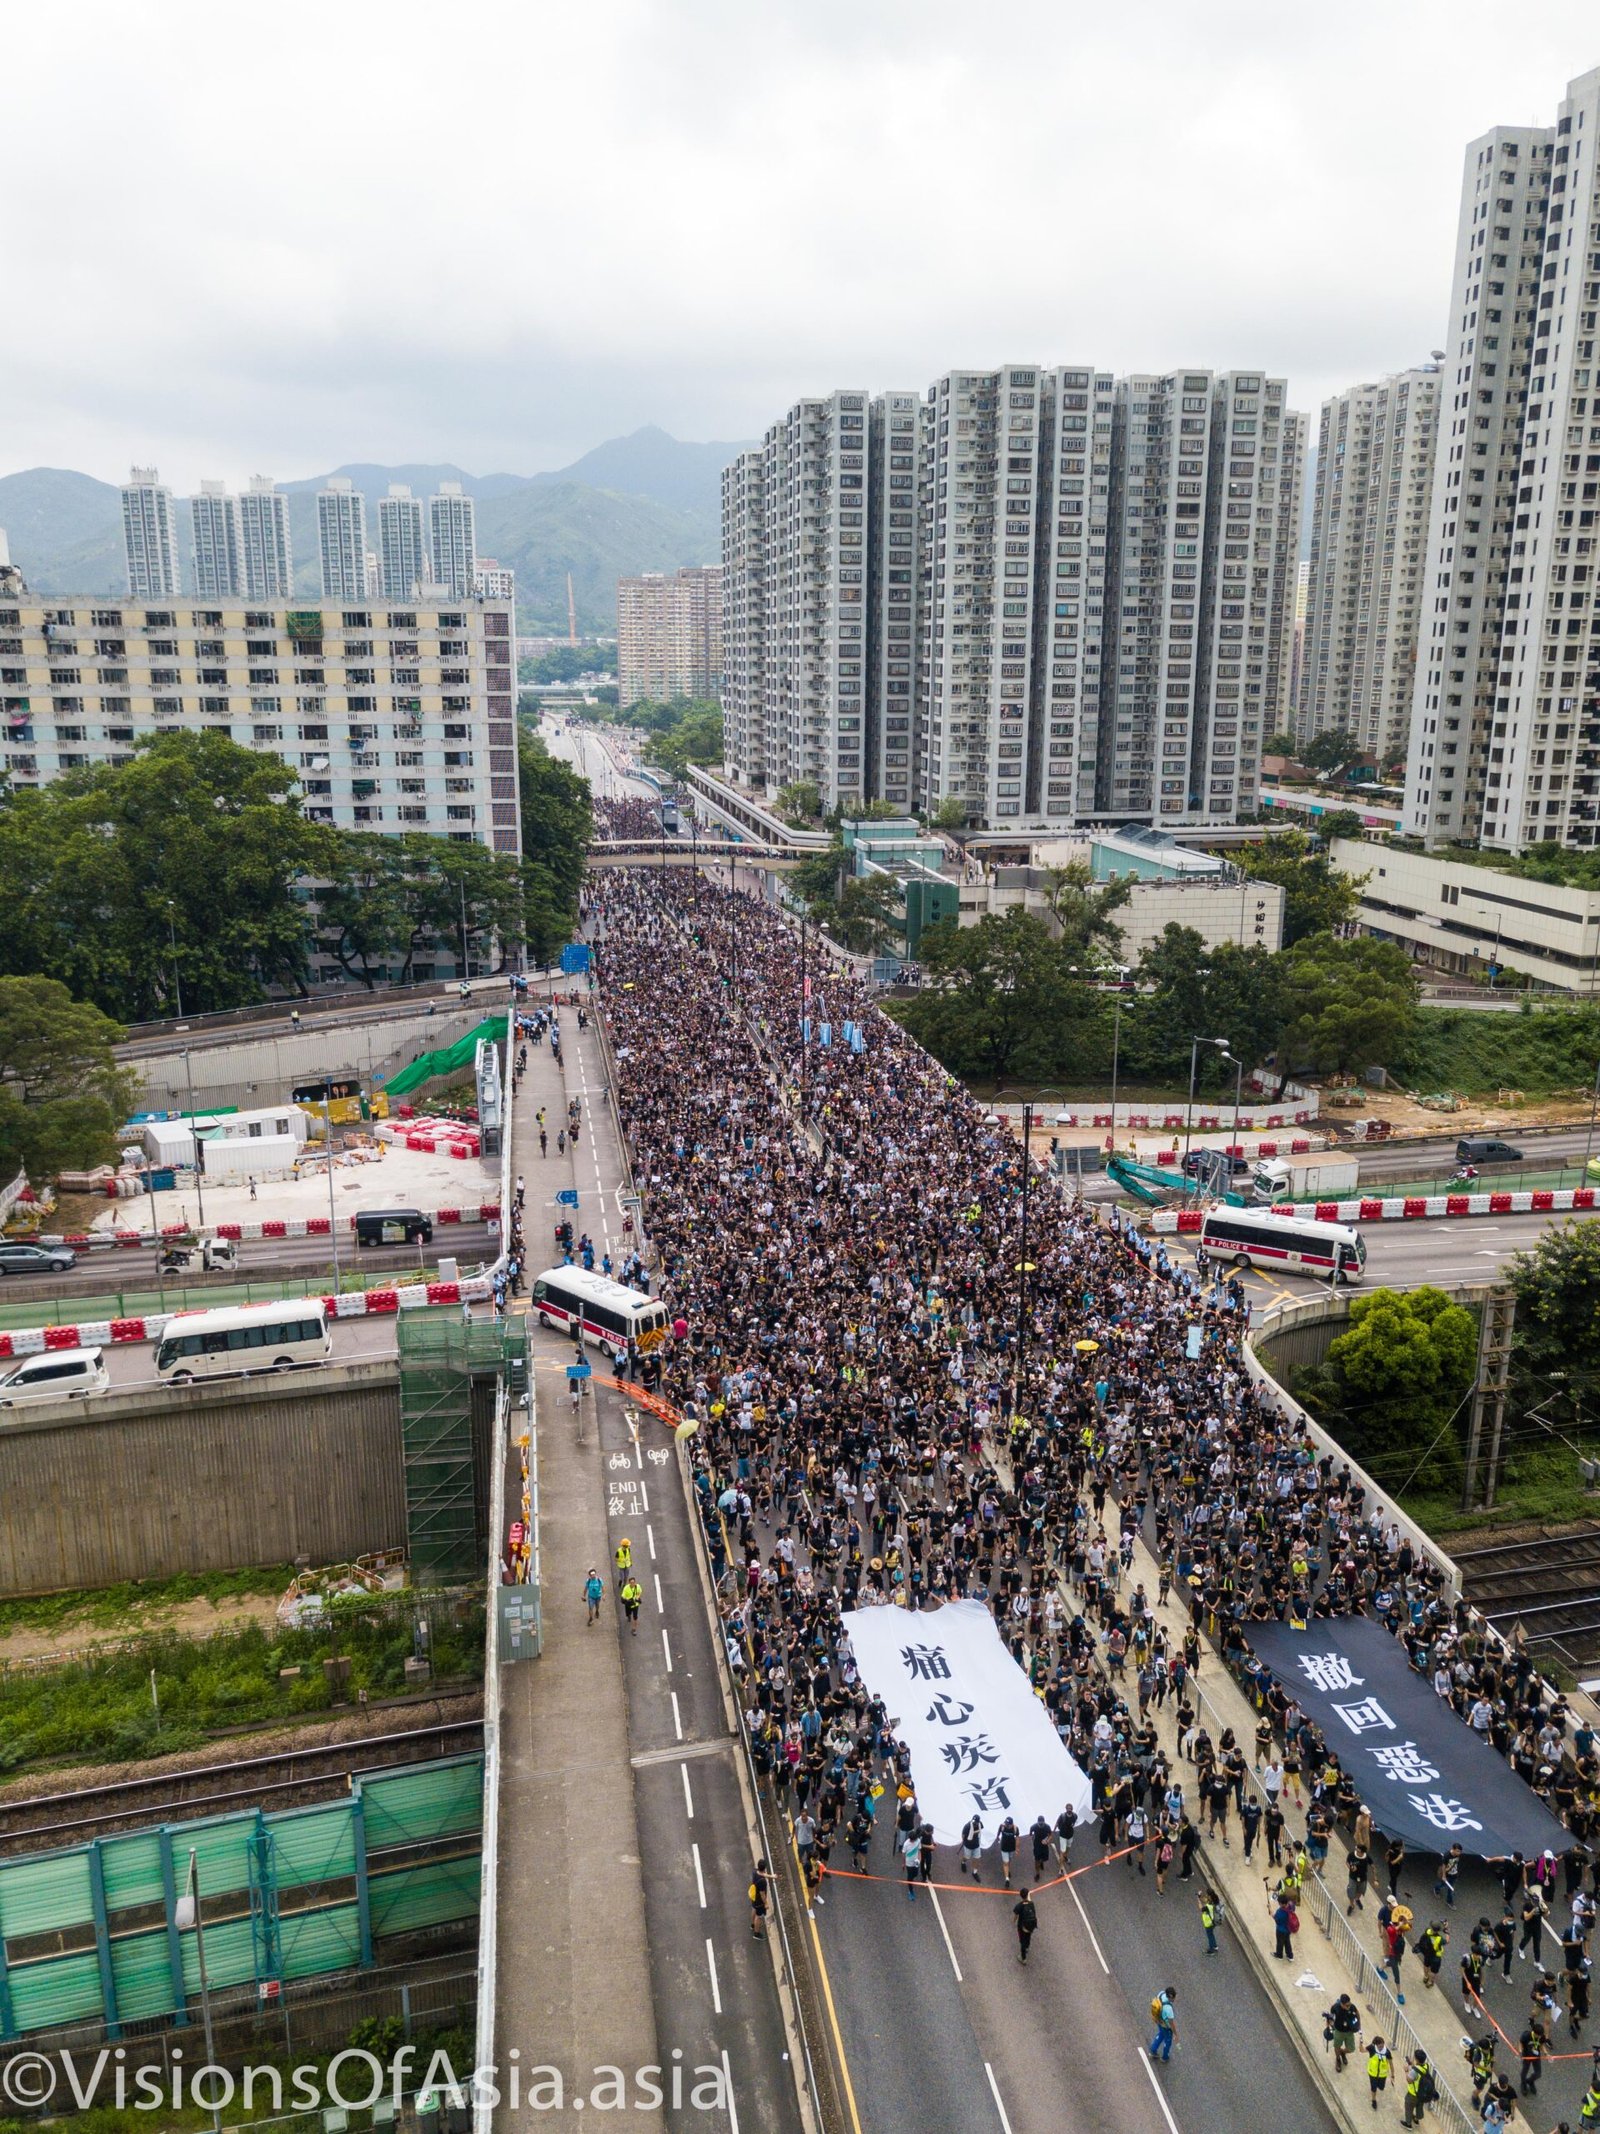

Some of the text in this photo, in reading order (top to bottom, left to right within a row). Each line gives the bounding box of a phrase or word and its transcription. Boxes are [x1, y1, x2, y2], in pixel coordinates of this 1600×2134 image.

[1218, 1241, 1240, 1250] POLICE
[609, 1481, 637, 1495] END
[608, 1495, 644, 1517] 終止
[898, 1642, 1011, 1813] 痛心疾首
[1296, 1652, 1484, 1832] 撤回惡法
